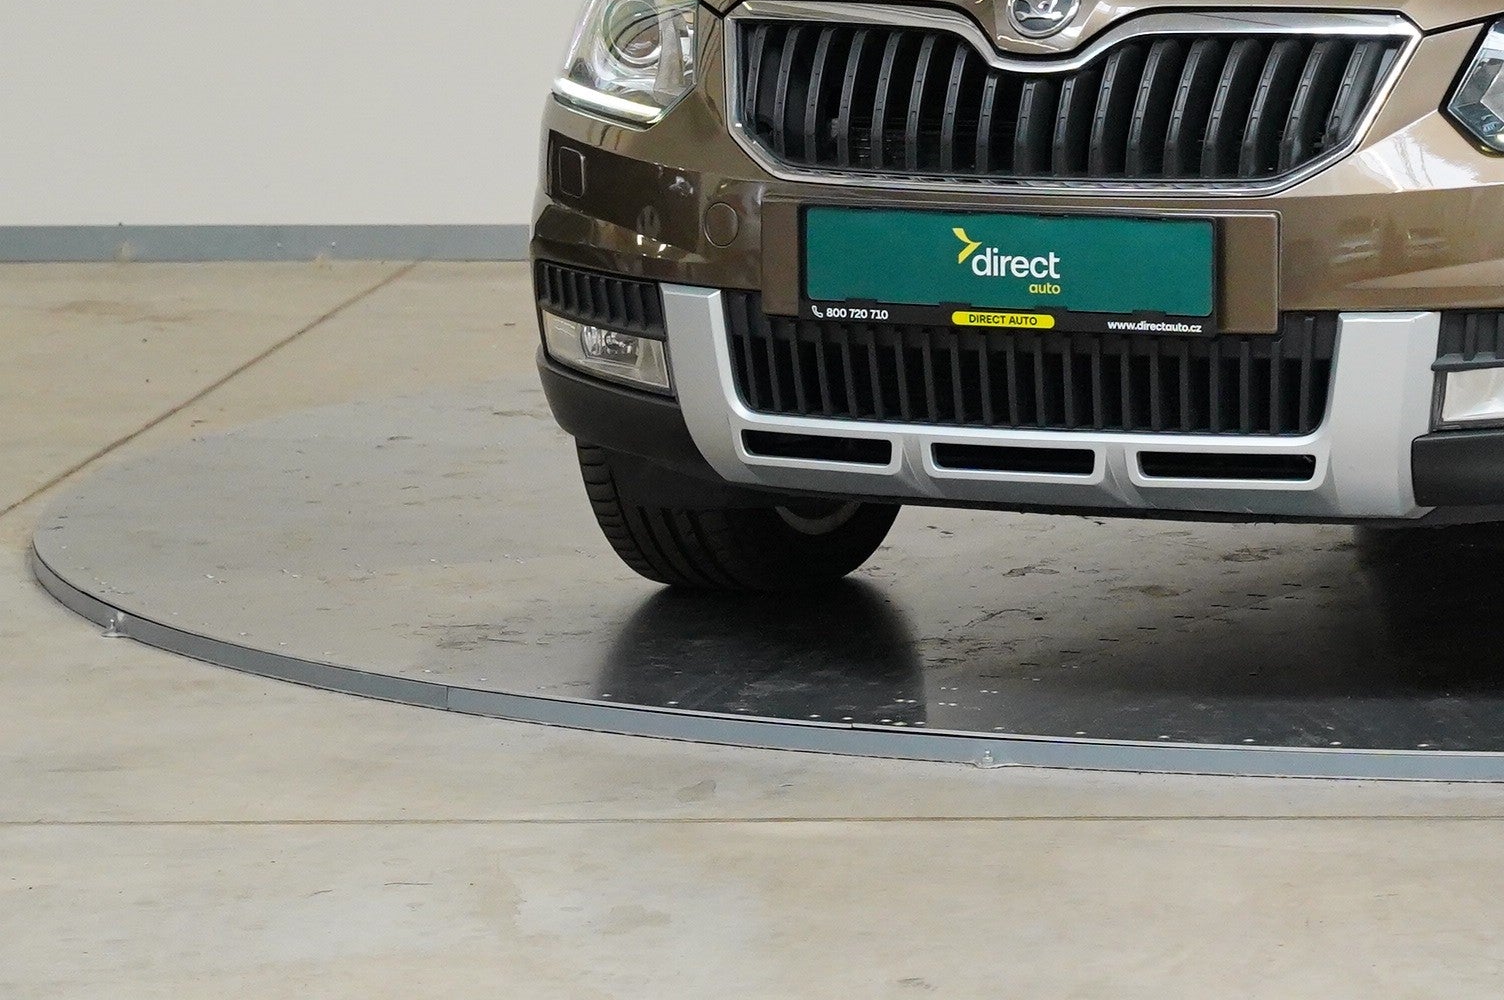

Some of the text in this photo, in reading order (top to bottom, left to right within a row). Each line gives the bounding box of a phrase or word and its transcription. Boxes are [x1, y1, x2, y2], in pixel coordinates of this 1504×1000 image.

[971, 247, 1061, 279] direct
[1028, 283, 1061, 294] auto
[826, 307, 889, 320] 800 720 710
[968, 314, 1038, 326] DIRECT AUTO
[1107, 320, 1203, 333] www.directauto.cz
